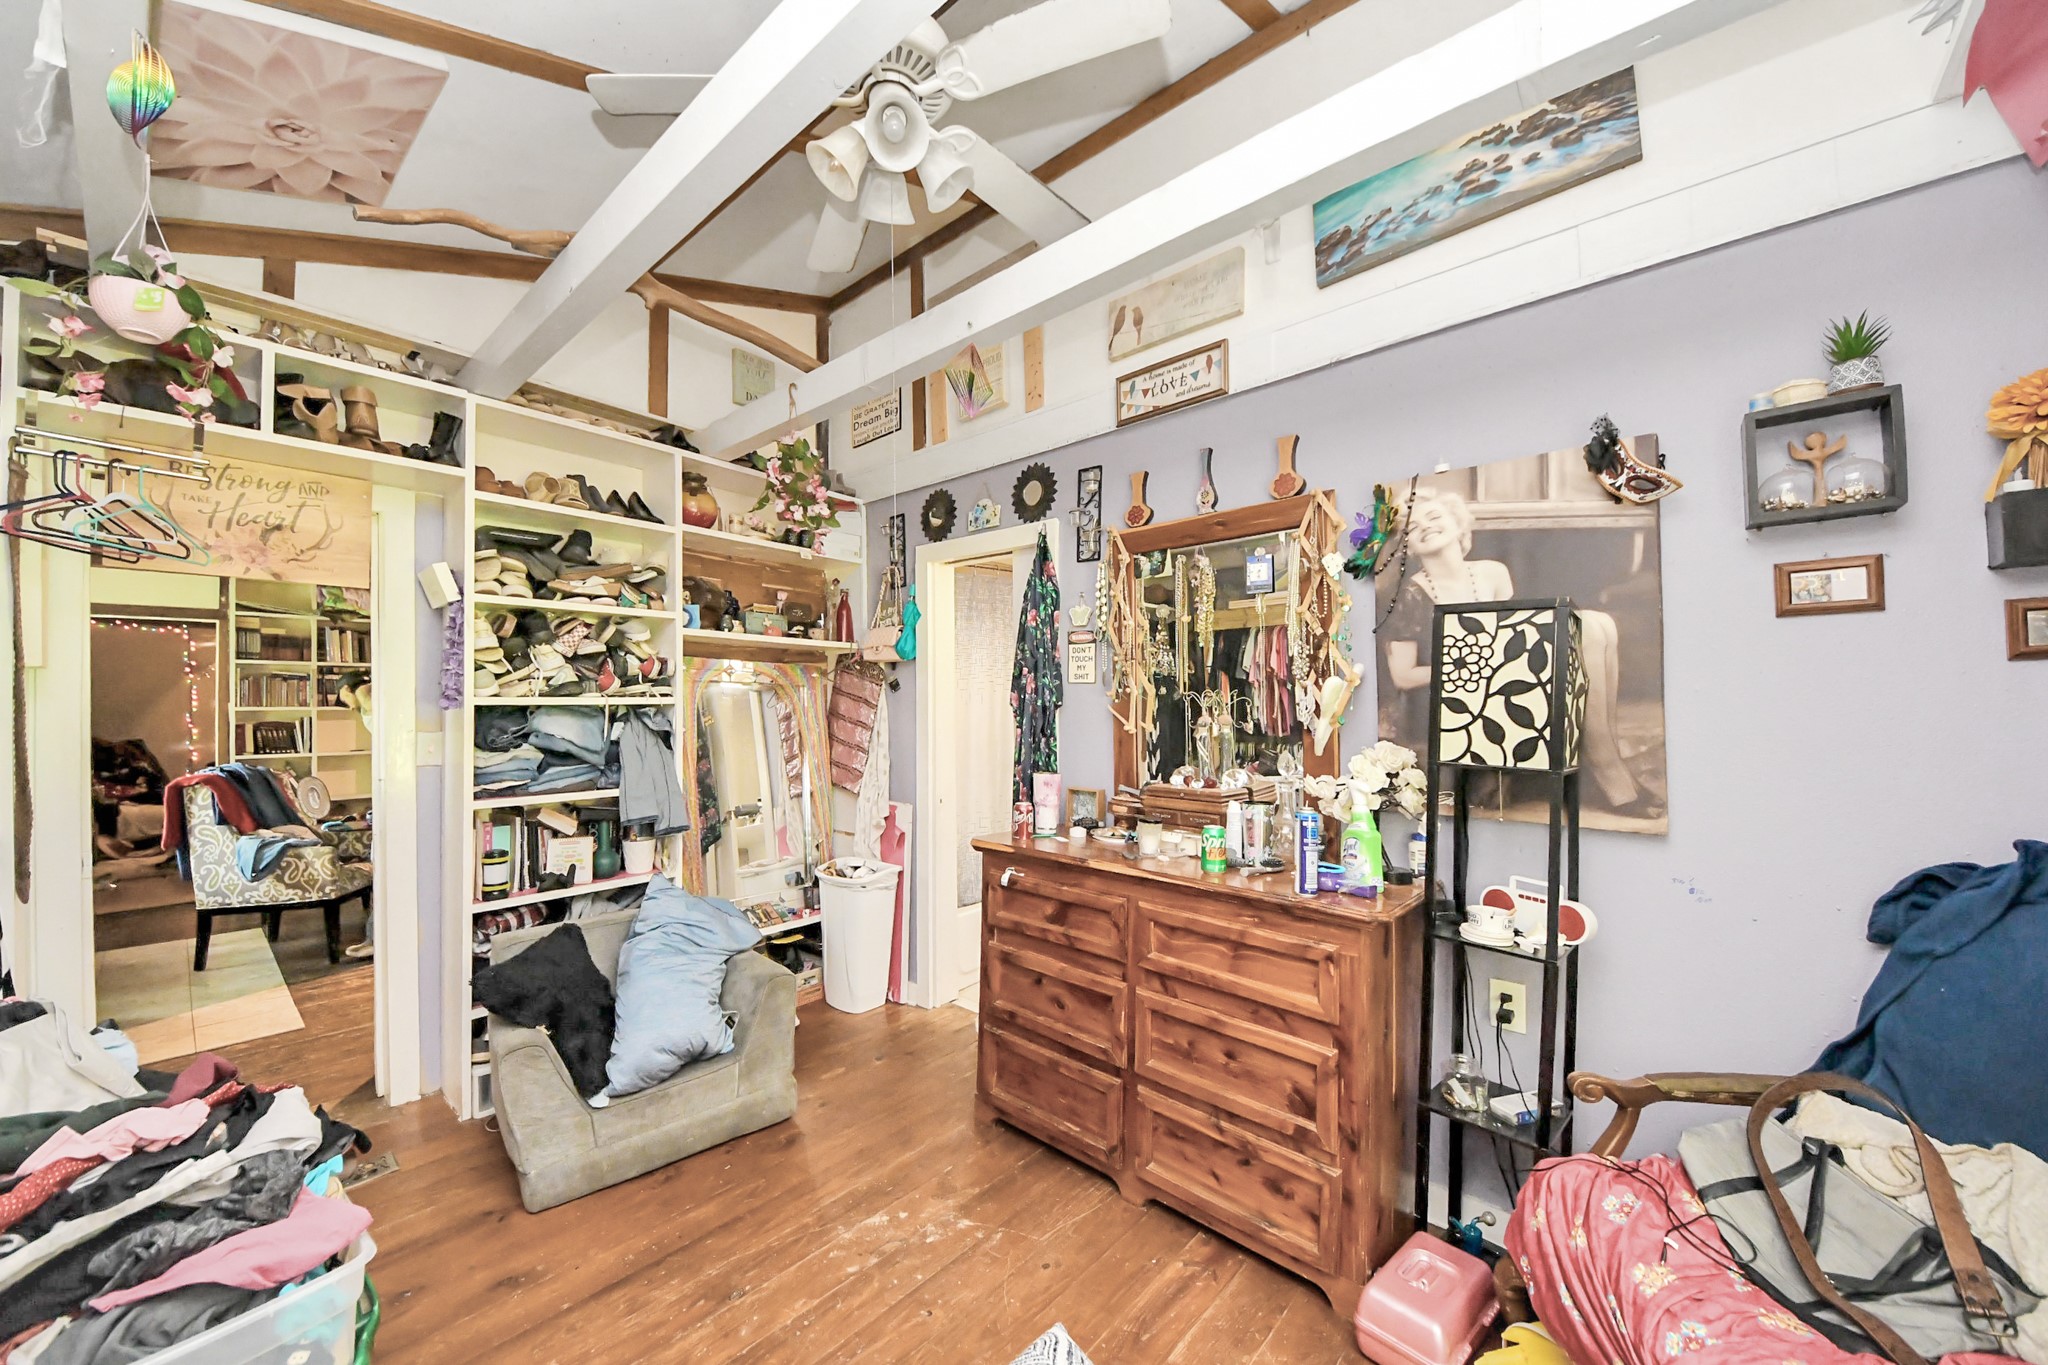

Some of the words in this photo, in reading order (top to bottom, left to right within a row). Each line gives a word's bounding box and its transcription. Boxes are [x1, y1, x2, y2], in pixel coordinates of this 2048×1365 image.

[1149, 371, 1165, 380] home
[1172, 363, 1188, 373] made
[1151, 372, 1188, 398] LOVE
[1175, 390, 1186, 398] and
[1187, 382, 1211, 395] dreams
[853, 414, 882, 432] Dream
[884, 406, 899, 419] Big
[200, 463, 295, 503] Strong
[298, 481, 331, 499] AND
[181, 493, 213, 504] TAKE
[197, 491, 321, 534] Heart
[1072, 646, 1092, 654] DON'T
[1071, 655, 1093, 663] TOUCH
